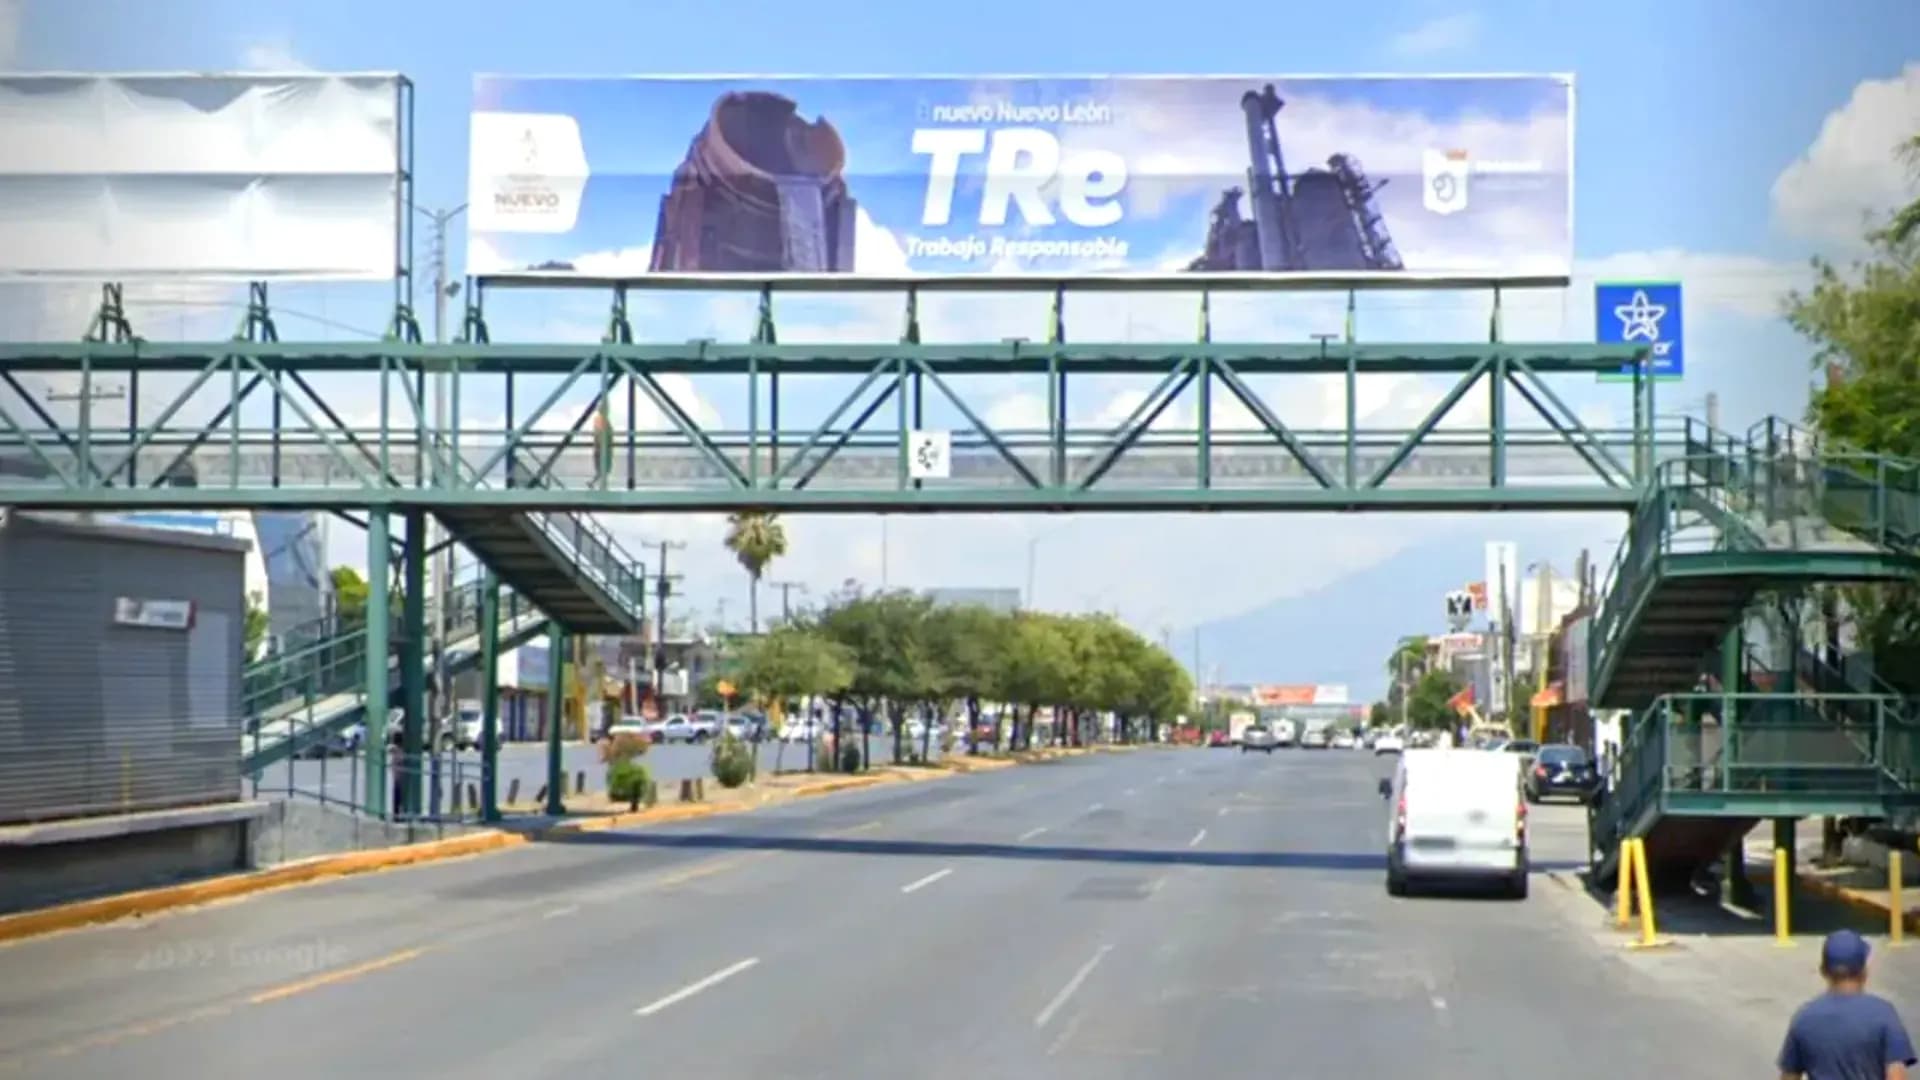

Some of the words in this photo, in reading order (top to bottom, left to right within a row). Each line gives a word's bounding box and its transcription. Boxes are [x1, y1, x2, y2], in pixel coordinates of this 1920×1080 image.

[933, 104, 993, 122] nuevo
[998, 101, 1060, 122] Nuevo
[1063, 99, 1110, 121] León
[911, 127, 1127, 227] TRe
[906, 236, 986, 262] Trabajo
[991, 236, 1129, 263] Responsable
